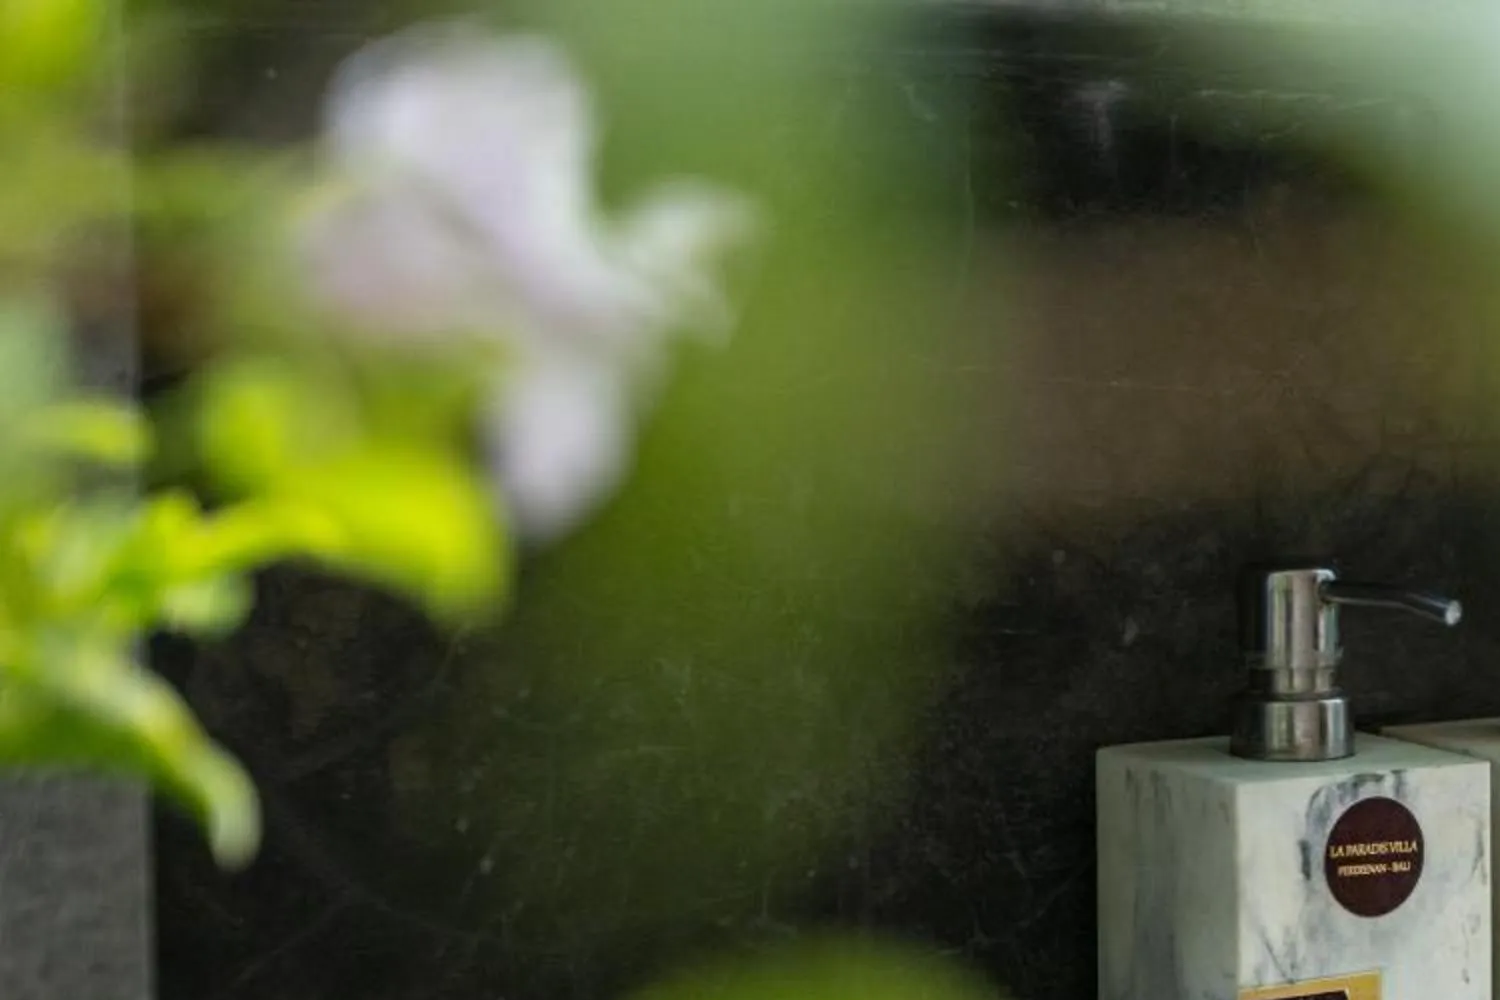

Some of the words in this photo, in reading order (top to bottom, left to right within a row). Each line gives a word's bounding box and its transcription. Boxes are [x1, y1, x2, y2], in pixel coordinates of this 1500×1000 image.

[1329, 845, 1344, 860] LA
[1345, 842, 1388, 857] PARADIS
[1389, 840, 1418, 854] VILLA
